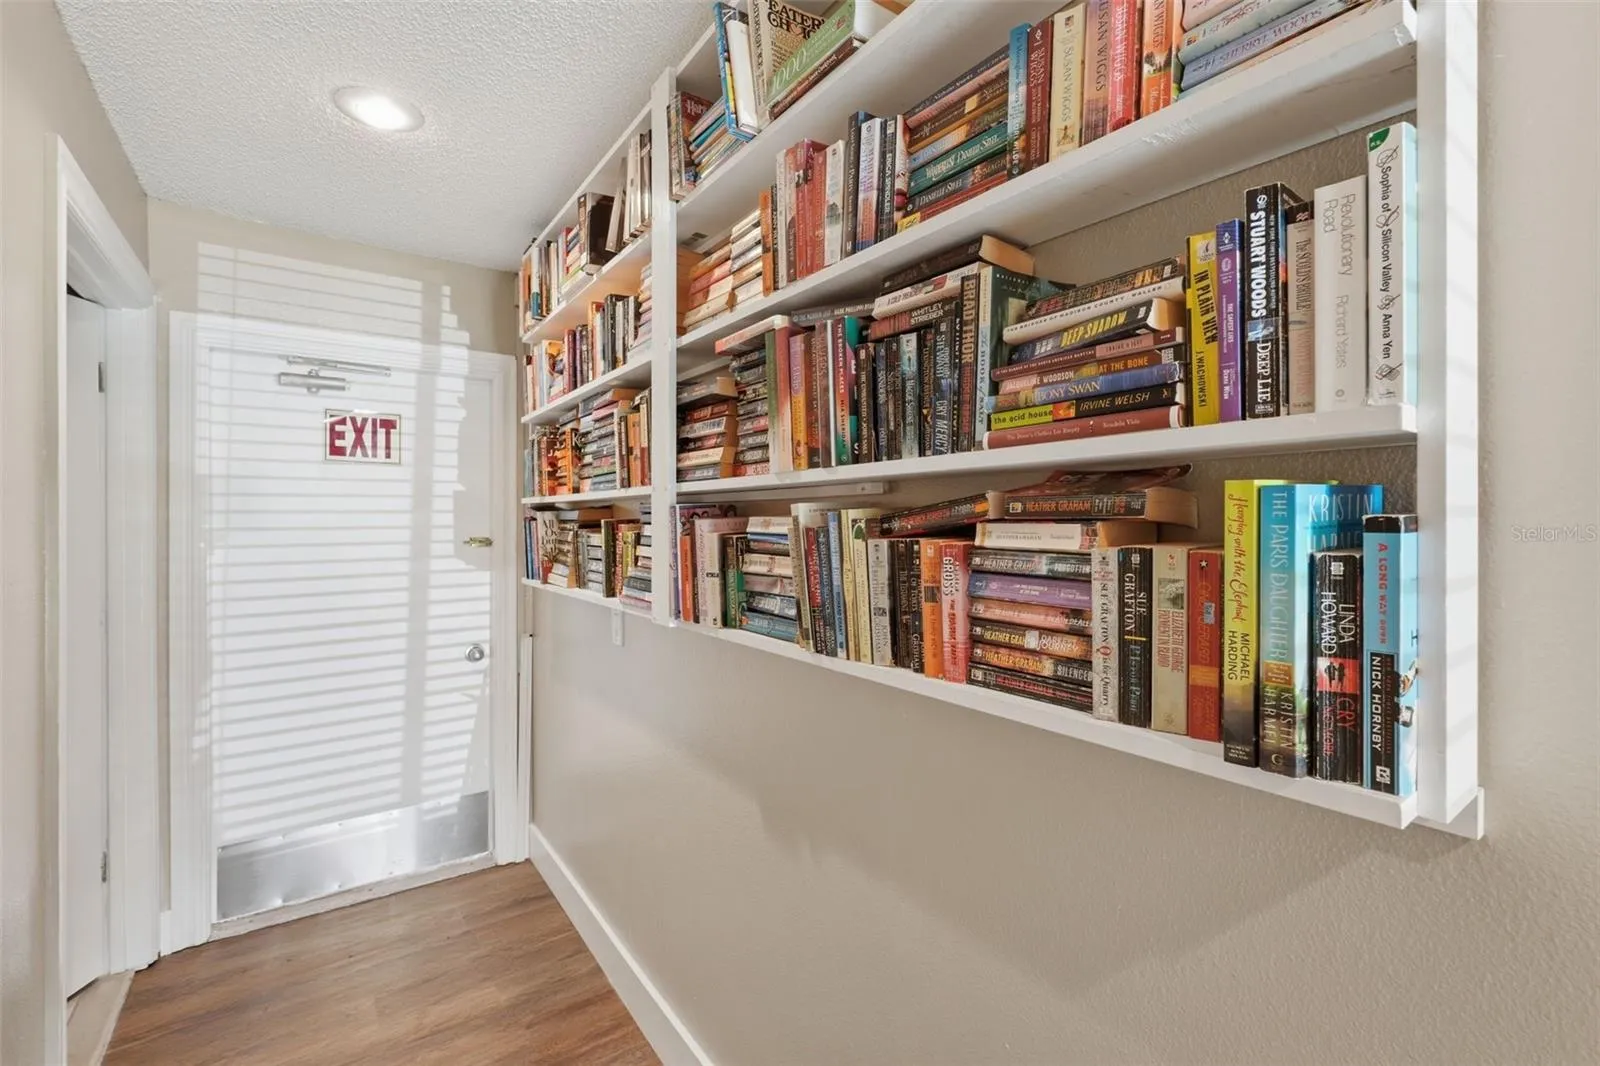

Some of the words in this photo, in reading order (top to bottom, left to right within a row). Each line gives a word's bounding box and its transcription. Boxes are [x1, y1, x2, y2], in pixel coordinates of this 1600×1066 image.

[1097, 0, 1109, 41] USAN
[1153, 13, 1165, 48] WIGGS
[1030, 52, 1038, 87] WIGGS
[1037, 47, 1045, 83] SUSAN
[1063, 46, 1074, 81] SUSAN
[1096, 43, 1109, 92] WIGGS
[1061, 82, 1074, 122] WIGGS
[885, 152, 893, 175] ERICA
[945, 179, 963, 193] STEEL
[1381, 164, 1392, 201] Sophia
[1323, 199, 1339, 234] Road
[1381, 202, 1391, 214] of
[1250, 210, 1266, 264] STUART
[1338, 193, 1356, 277] Revolutionary
[1381, 228, 1392, 262] Silicon
[1193, 269, 1209, 284] IN
[1250, 265, 1267, 319] WOODS
[1379, 262, 1392, 293] Valley
[911, 302, 943, 317] WHITLEY
[962, 278, 976, 319] BRAD
[1019, 319, 1048, 330] BRIDGES
[1059, 306, 1091, 319] MADISON
[1094, 296, 1125, 309] COUNTY
[1131, 285, 1162, 298] WALLER
[1197, 285, 1215, 318] PLAIN
[911, 310, 944, 326] STRIEBER
[1060, 326, 1084, 348] DEEP
[1085, 310, 1128, 338] SHADOW
[1204, 316, 1218, 345] VIEW
[1336, 294, 1349, 338] Richard
[1382, 312, 1392, 338] Anna
[935, 335, 945, 378] STEWART
[961, 321, 975, 364] THOR
[1256, 342, 1271, 375] DEEP
[1335, 339, 1349, 369] Yates
[1382, 339, 1392, 360] Yen
[1042, 371, 1074, 383] WOODSON
[1099, 365, 1110, 373] AT
[1111, 360, 1124, 371] THE
[1127, 356, 1149, 368] BONE
[1068, 381, 1101, 396] SWAN
[1080, 396, 1111, 411] IRVINE
[1114, 391, 1150, 406] WELSH
[1256, 379, 1271, 403] LIE
[935, 400, 948, 417] CRY
[994, 416, 1007, 424] the
[1009, 413, 1026, 423] acid
[1028, 409, 1053, 420] house
[328, 415, 398, 459] EXIT
[935, 418, 948, 454] MERCY
[1026, 502, 1056, 512] HEATHER
[1058, 501, 1091, 512] GRAHAM
[1228, 493, 1249, 536] Hanging
[1272, 491, 1287, 518] THE
[1308, 493, 1374, 522] KRISTIN
[811, 544, 819, 572] VINCE
[1233, 537, 1245, 558] with
[1270, 524, 1288, 568] PARIS
[1378, 543, 1388, 552] A
[943, 556, 955, 597] GROSS
[983, 559, 1012, 569] HEATHER
[1233, 559, 1245, 577] the
[1378, 558, 1388, 590] LONG
[812, 573, 821, 604] FLYNN
[911, 589, 919, 613] TORTS
[1100, 583, 1108, 600] SUE
[1123, 573, 1136, 632] GRAFTON
[1135, 591, 1147, 616] SUE
[1228, 579, 1249, 623] Elephant
[1378, 594, 1388, 615] WAY
[1100, 601, 1109, 643] GRAFTON
[1157, 609, 1171, 638] PAYMENT
[1171, 610, 1184, 645] ELIZABETH
[1269, 572, 1288, 660] DAUGHTER
[1320, 591, 1336, 654] HOWARD
[1338, 603, 1355, 644] LINDA
[1379, 619, 1387, 645] DOWN
[912, 633, 921, 670] GRISHAM
[984, 629, 1009, 642] HEATHER
[1096, 645, 1112, 657] Q
[985, 650, 1013, 665] HEATHER
[1157, 646, 1171, 668] BLOOD
[1171, 646, 1184, 673] GEORGE
[1227, 630, 1238, 681] HARDING
[1239, 632, 1250, 681] MICHAEL
[1056, 664, 1093, 681] SILENCED
[1371, 656, 1382, 689] NICK
[1099, 675, 1112, 706] Quarry
[1263, 688, 1276, 744] HARMEL
[1280, 692, 1293, 750] KRISTIN
[1322, 706, 1335, 723] NO
[1336, 697, 1355, 731] CRY
[1371, 693, 1382, 752] HORNBY
[1322, 728, 1336, 757] MORE
